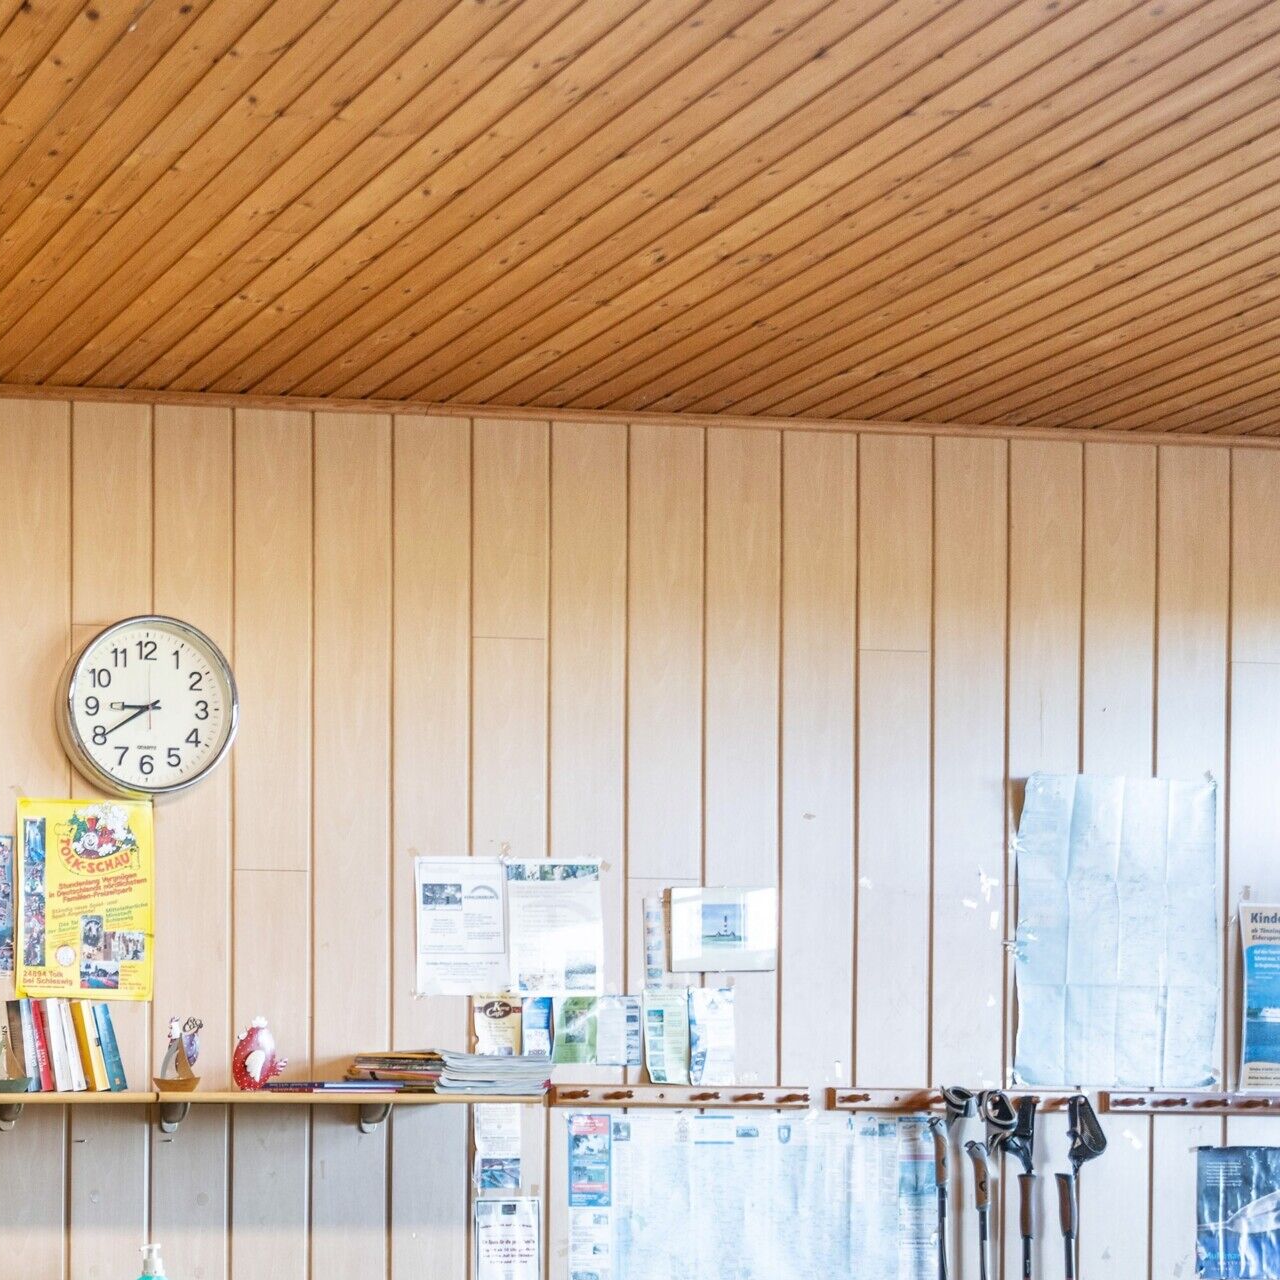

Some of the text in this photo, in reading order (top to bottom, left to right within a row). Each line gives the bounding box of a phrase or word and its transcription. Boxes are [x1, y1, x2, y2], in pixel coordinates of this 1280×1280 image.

[112, 648, 127, 667] 11
[136, 641, 157, 660] 12
[172, 650, 179, 670] 1
[89, 669, 111, 688] 10
[189, 672, 202, 691] 2
[85, 696, 99, 716] 9
[195, 700, 209, 720] 3
[92, 725, 106, 745] 8
[185, 728, 201, 747] 4
[114, 747, 129, 766] 7
[140, 755, 154, 774] 6
[167, 748, 181, 767] 5
[60, 838, 131, 874] TOLK-SCHAU
[36, 978, 73, 986] Schleswig
